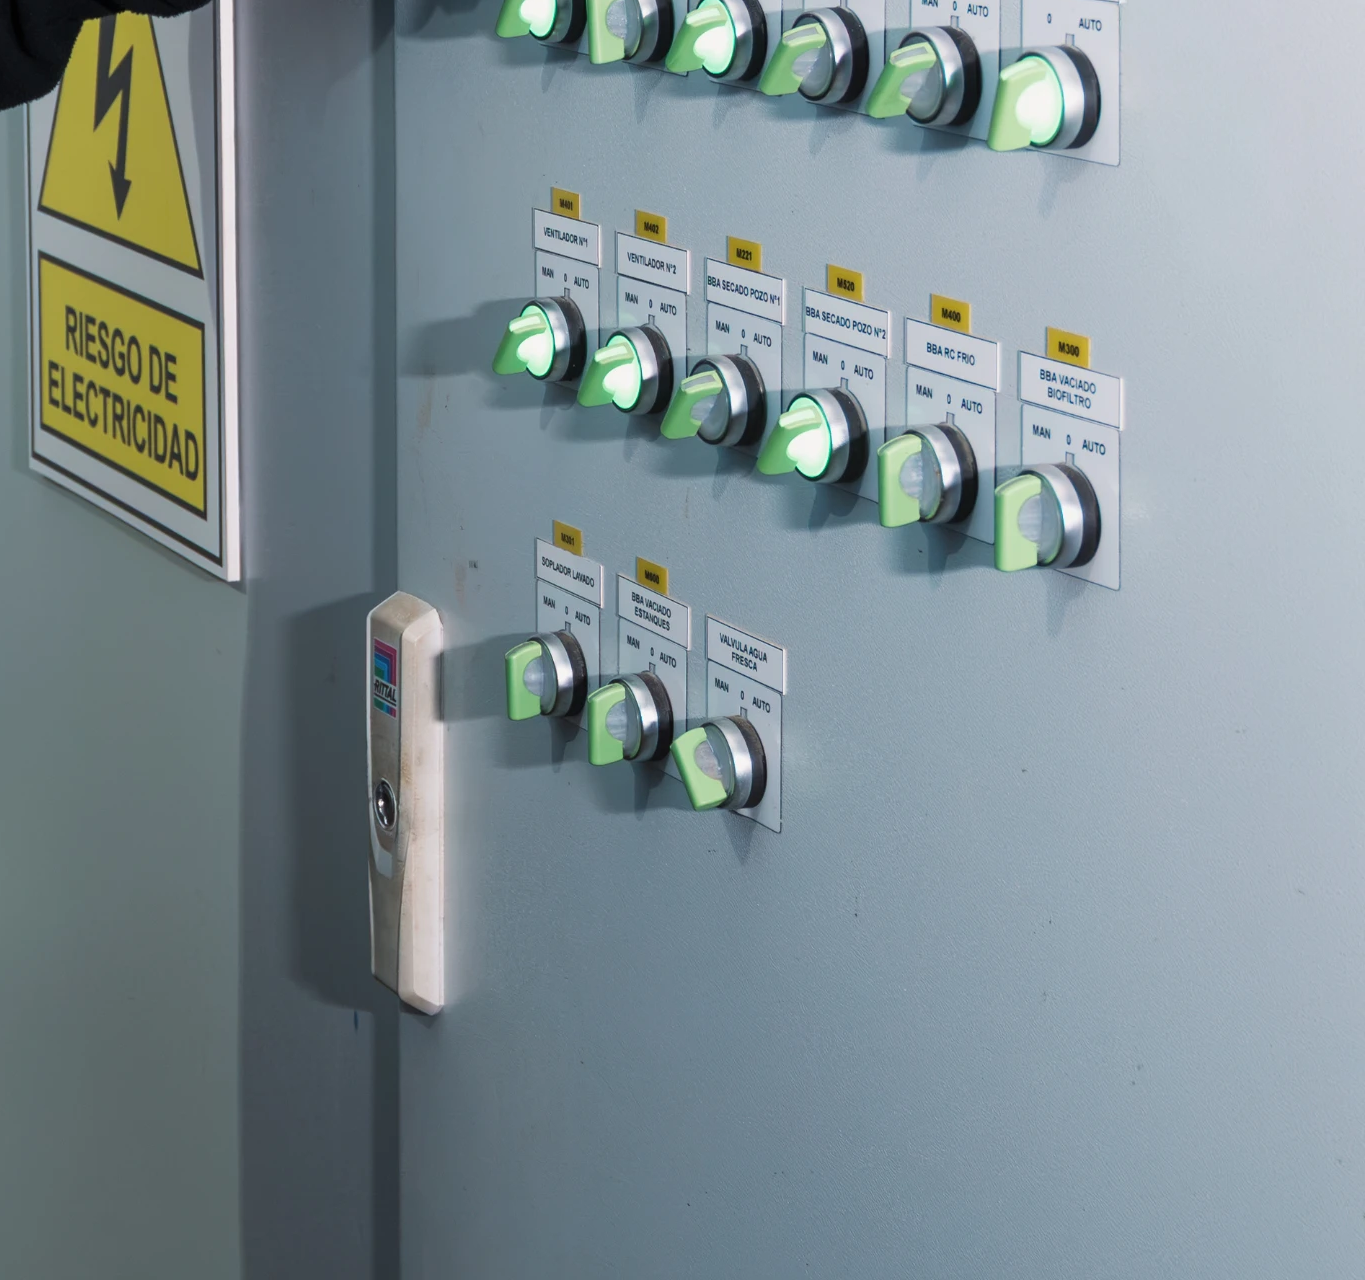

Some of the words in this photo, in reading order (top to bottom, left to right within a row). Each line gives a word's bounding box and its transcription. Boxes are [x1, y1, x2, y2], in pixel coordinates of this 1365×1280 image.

[967, 4, 989, 17] AUTO
[1079, 18, 1102, 31] AUTO
[543, 227, 578, 244] VENTILADOR
[644, 221, 659, 234] M402
[627, 252, 664, 270] VENTILADOR
[736, 248, 752, 261] M221
[542, 267, 554, 279] MAN
[574, 276, 589, 289] AUTO
[707, 275, 721, 289] BBA
[722, 279, 749, 296] SECADO
[750, 286, 769, 302] POZO
[837, 277, 855, 292] M520
[625, 292, 639, 305] MAN
[660, 302, 677, 315] AUTO
[941, 308, 961, 323] M400
[805, 306, 820, 320] BBA
[821, 309, 850, 329] SECADO
[852, 318, 873, 335] POZO
[715, 320, 730, 334] MAN
[753, 332, 772, 347] AUTO
[65, 304, 142, 385] RIESGO
[149, 344, 178, 405] DE
[926, 342, 943, 357] BBA
[945, 348, 956, 360] RC
[957, 351, 975, 366] FRIO
[1058, 341, 1080, 357] M300
[812, 351, 828, 365] MAN
[854, 364, 874, 380] AUTO
[1040, 369, 1057, 384] BBA
[1058, 374, 1097, 395] VACIADO
[916, 384, 933, 399] MAN
[961, 398, 983, 415] AUTO
[1047, 387, 1092, 409] BIOFILTRO
[48, 360, 199, 482] ELECTRICIDAD
[1032, 425, 1051, 440] MAN
[1082, 439, 1106, 456] AUTO
[541, 556, 571, 577] SOPLADOR
[572, 569, 595, 587] LAVADO
[543, 596, 556, 609] MAN
[575, 610, 591, 626] AUTO
[631, 591, 644, 605] BBA
[645, 597, 672, 618] VACIADO
[634, 607, 671, 631] ESTANQUES
[627, 635, 640, 649] MAN
[659, 651, 677, 668] AUTO
[719, 633, 748, 654] VALVULA
[748, 646, 768, 663] AGUA
[731, 651, 758, 672] FRESCA
[374, 679, 396, 702] RITTAL
[715, 678, 729, 693] MAN
[752, 697, 770, 713] AUTO
